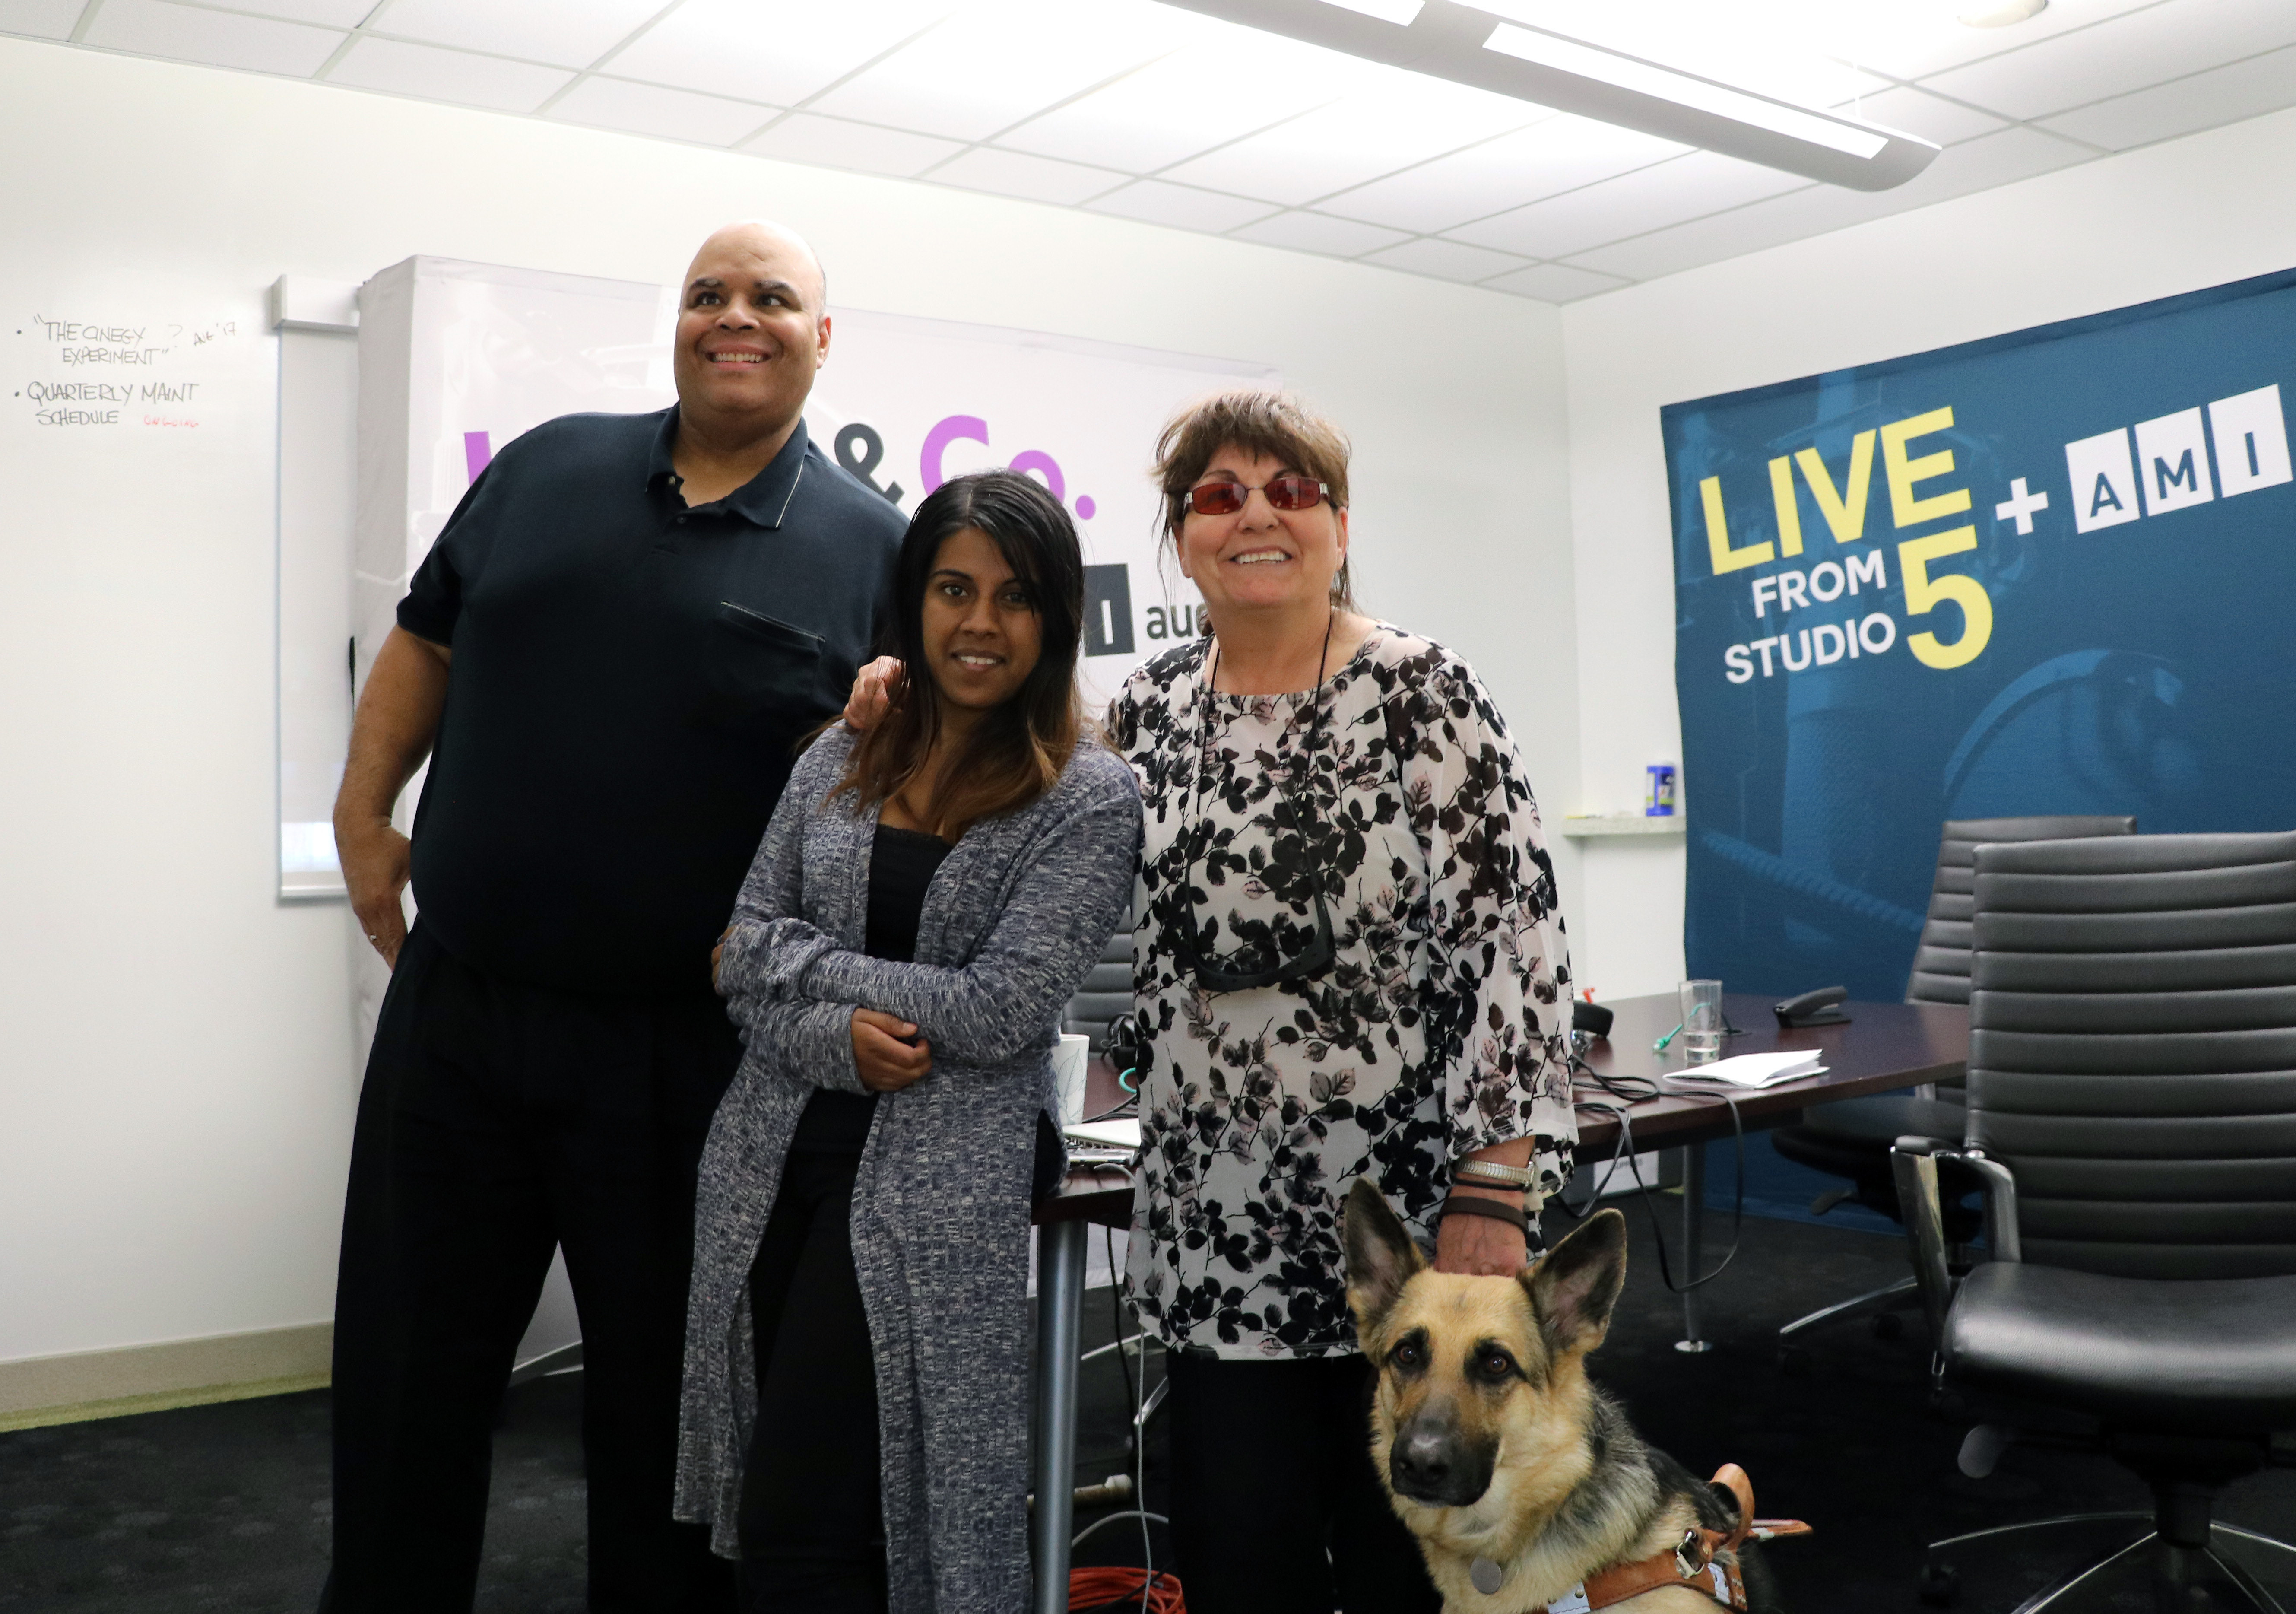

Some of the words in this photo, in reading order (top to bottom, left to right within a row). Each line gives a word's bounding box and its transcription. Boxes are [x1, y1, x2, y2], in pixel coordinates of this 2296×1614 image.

[27, 381, 134, 407] QUARTERLY
[141, 382, 200, 405] MAINT
[35, 407, 120, 426] SCHEDULE
[1700, 406, 1972, 575] LIVE
[1725, 612, 1896, 684] STUDIO
[1898, 524, 1993, 669] 5
[1752, 549, 1887, 618] FROM
